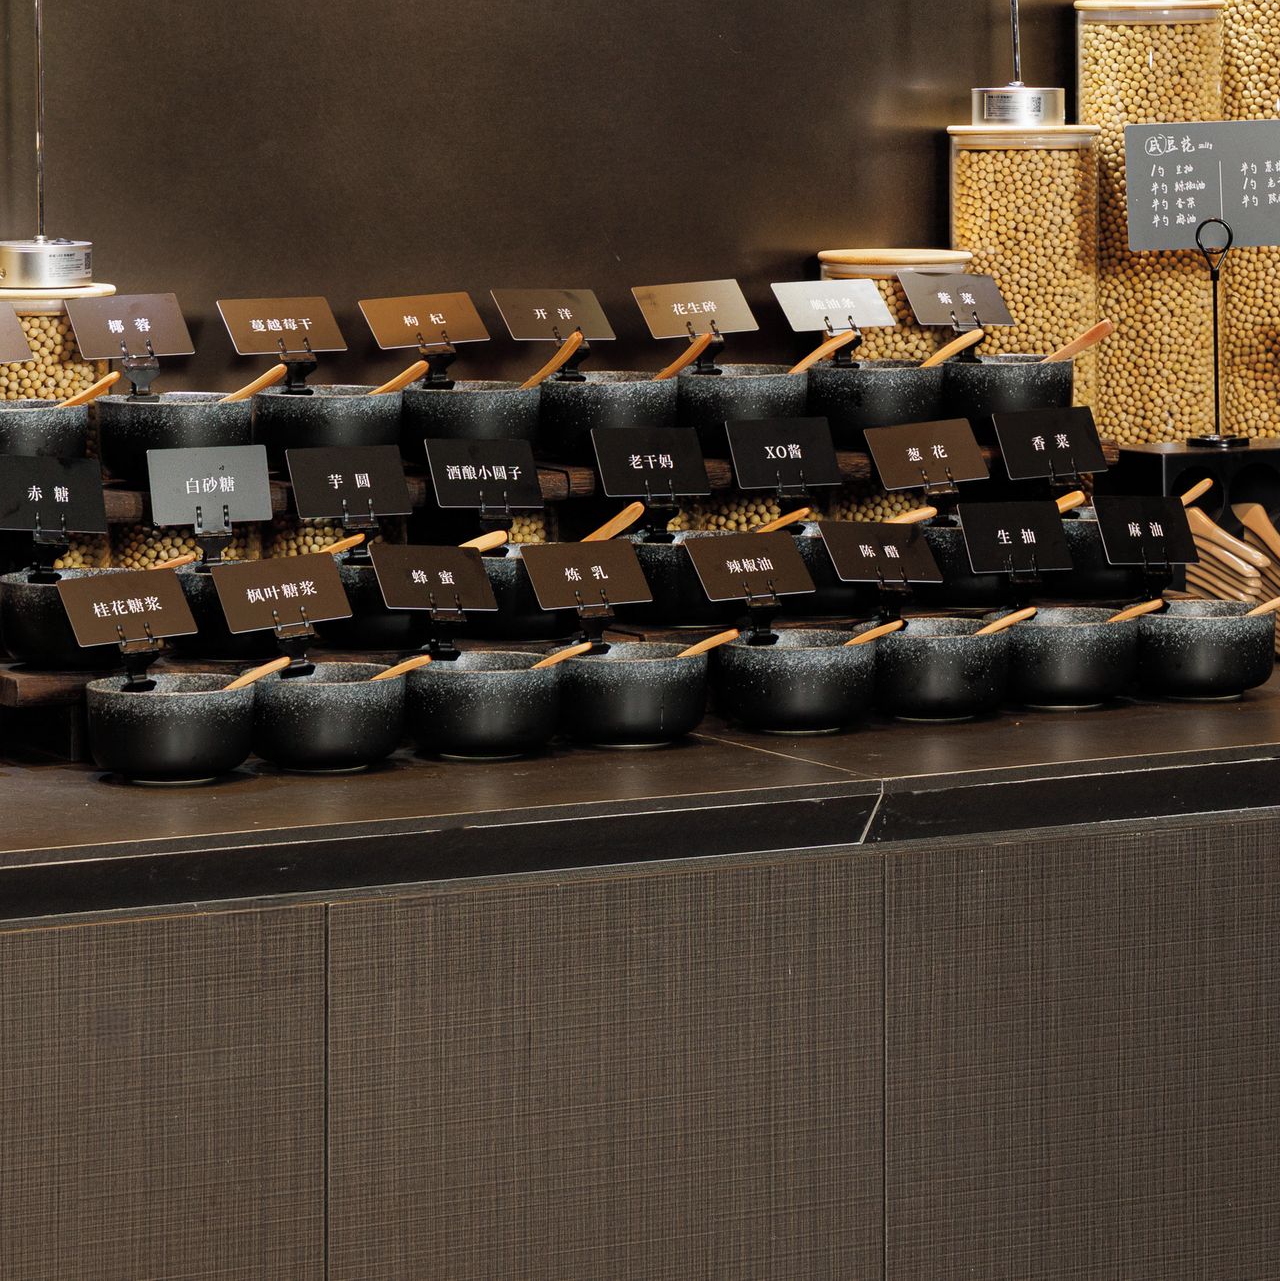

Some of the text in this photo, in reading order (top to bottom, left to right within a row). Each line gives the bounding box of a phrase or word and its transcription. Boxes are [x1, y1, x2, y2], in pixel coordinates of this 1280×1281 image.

[937, 291, 976, 306] 紫菜
[533, 307, 573, 321] 开洋
[672, 301, 717, 316] 花生碎
[108, 317, 152, 334] 椰蓉
[249, 317, 312, 333] 蔓越莓干
[403, 313, 446, 327] 枸杞
[1031, 433, 1070, 451] 香菜
[764, 443, 802, 460] XO酱
[906, 444, 948, 462] 葱花
[628, 453, 674, 469] 老干妈
[327, 472, 371, 490] 芋圆
[446, 464, 522, 481] 酒酿小圆子
[27, 484, 70, 503] 赤糖
[185, 475, 236, 495] 白砂糖
[997, 527, 1037, 545] 生抽
[1127, 521, 1164, 538] 麻油
[858, 544, 899, 559] 陈醋
[564, 565, 609, 582] 炼乳
[726, 556, 774, 574] 辣椒油
[411, 568, 456, 586] 蜂蜜
[246, 579, 318, 604] 枫叶糖浆
[92, 595, 163, 619] 桂花糖浆
